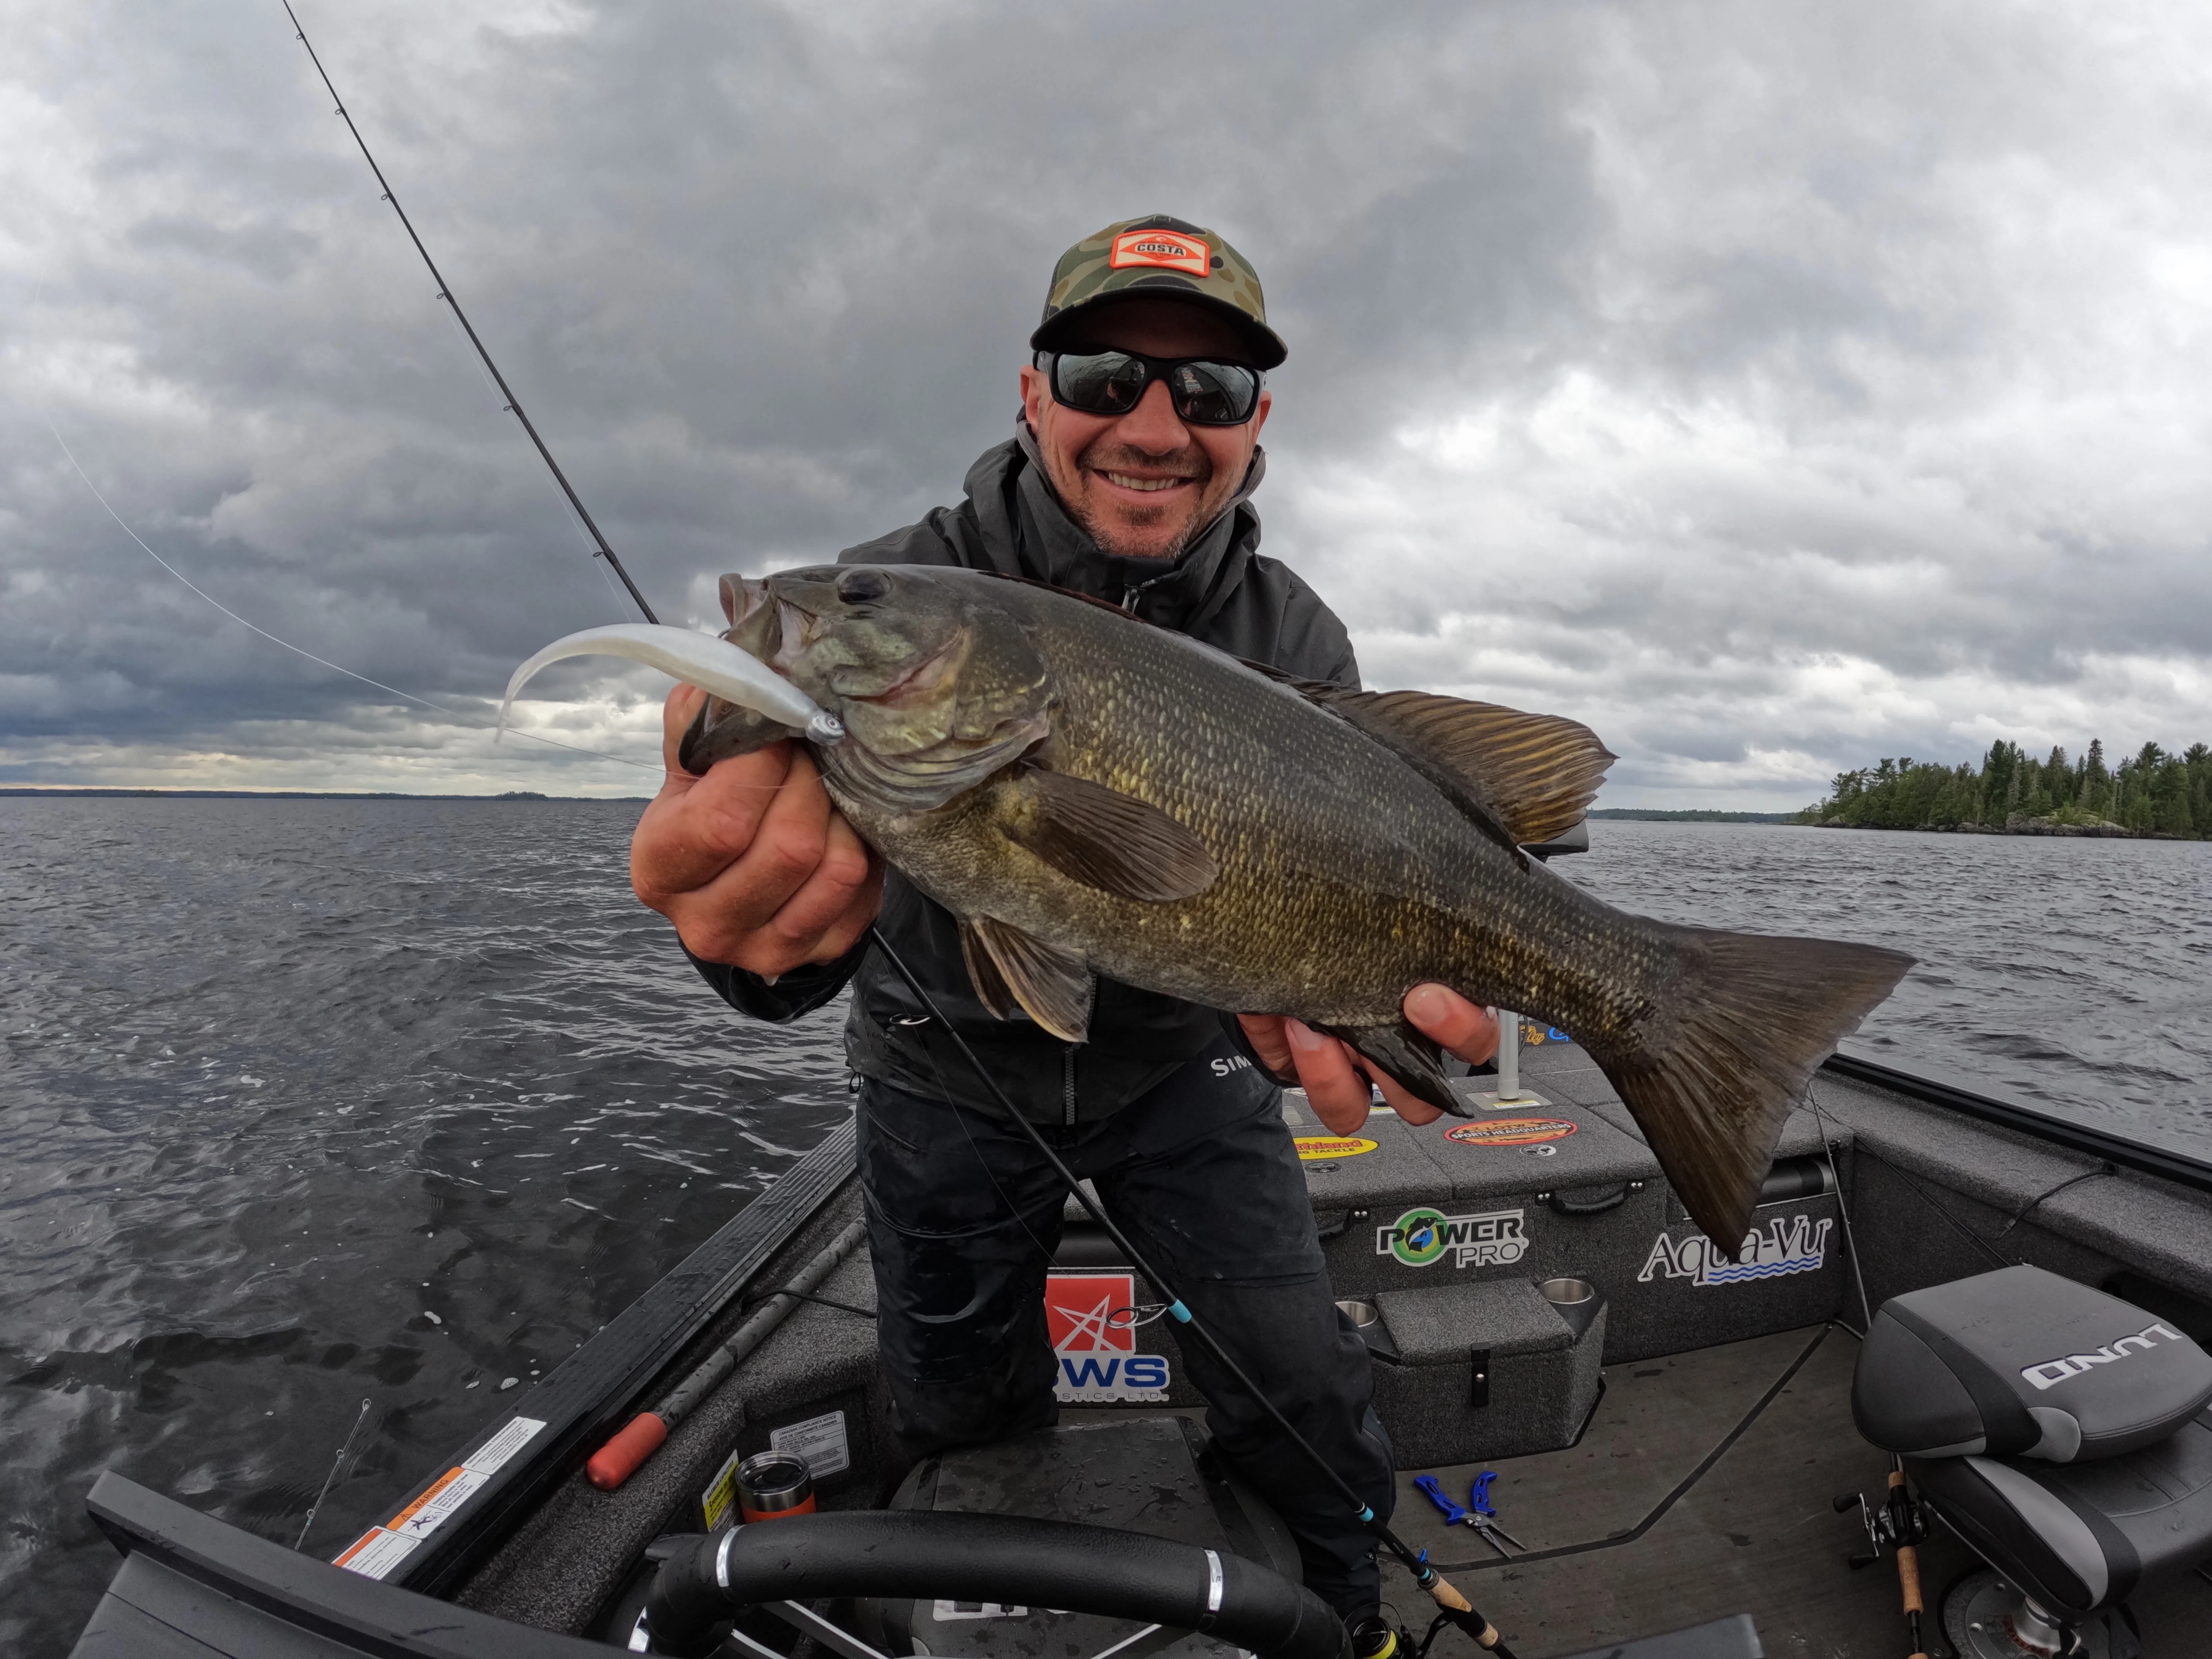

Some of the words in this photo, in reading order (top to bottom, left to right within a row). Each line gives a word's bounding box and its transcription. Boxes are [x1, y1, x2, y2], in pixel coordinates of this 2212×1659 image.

[1137, 244, 1184, 256] COSTA
[1210, 1055, 1252, 1077] SIM
[1491, 1123, 1572, 1135] HEADQUARTERS
[1295, 1139, 1363, 1150] rthland
[1380, 1217, 1520, 1252] POWER
[1460, 1243, 1520, 1265] PRO
[1641, 1218, 1828, 1283] Aqua-Vu
[2020, 1323, 2183, 1390] LUND
[1054, 1358, 1167, 1388] WS
[778, 1427, 797, 1436] CANADIAN
[798, 1419, 822, 1430] COMPLIANCE
[818, 1419, 837, 1428] CANADIEN
[411, 1479, 449, 1509] WARNING
